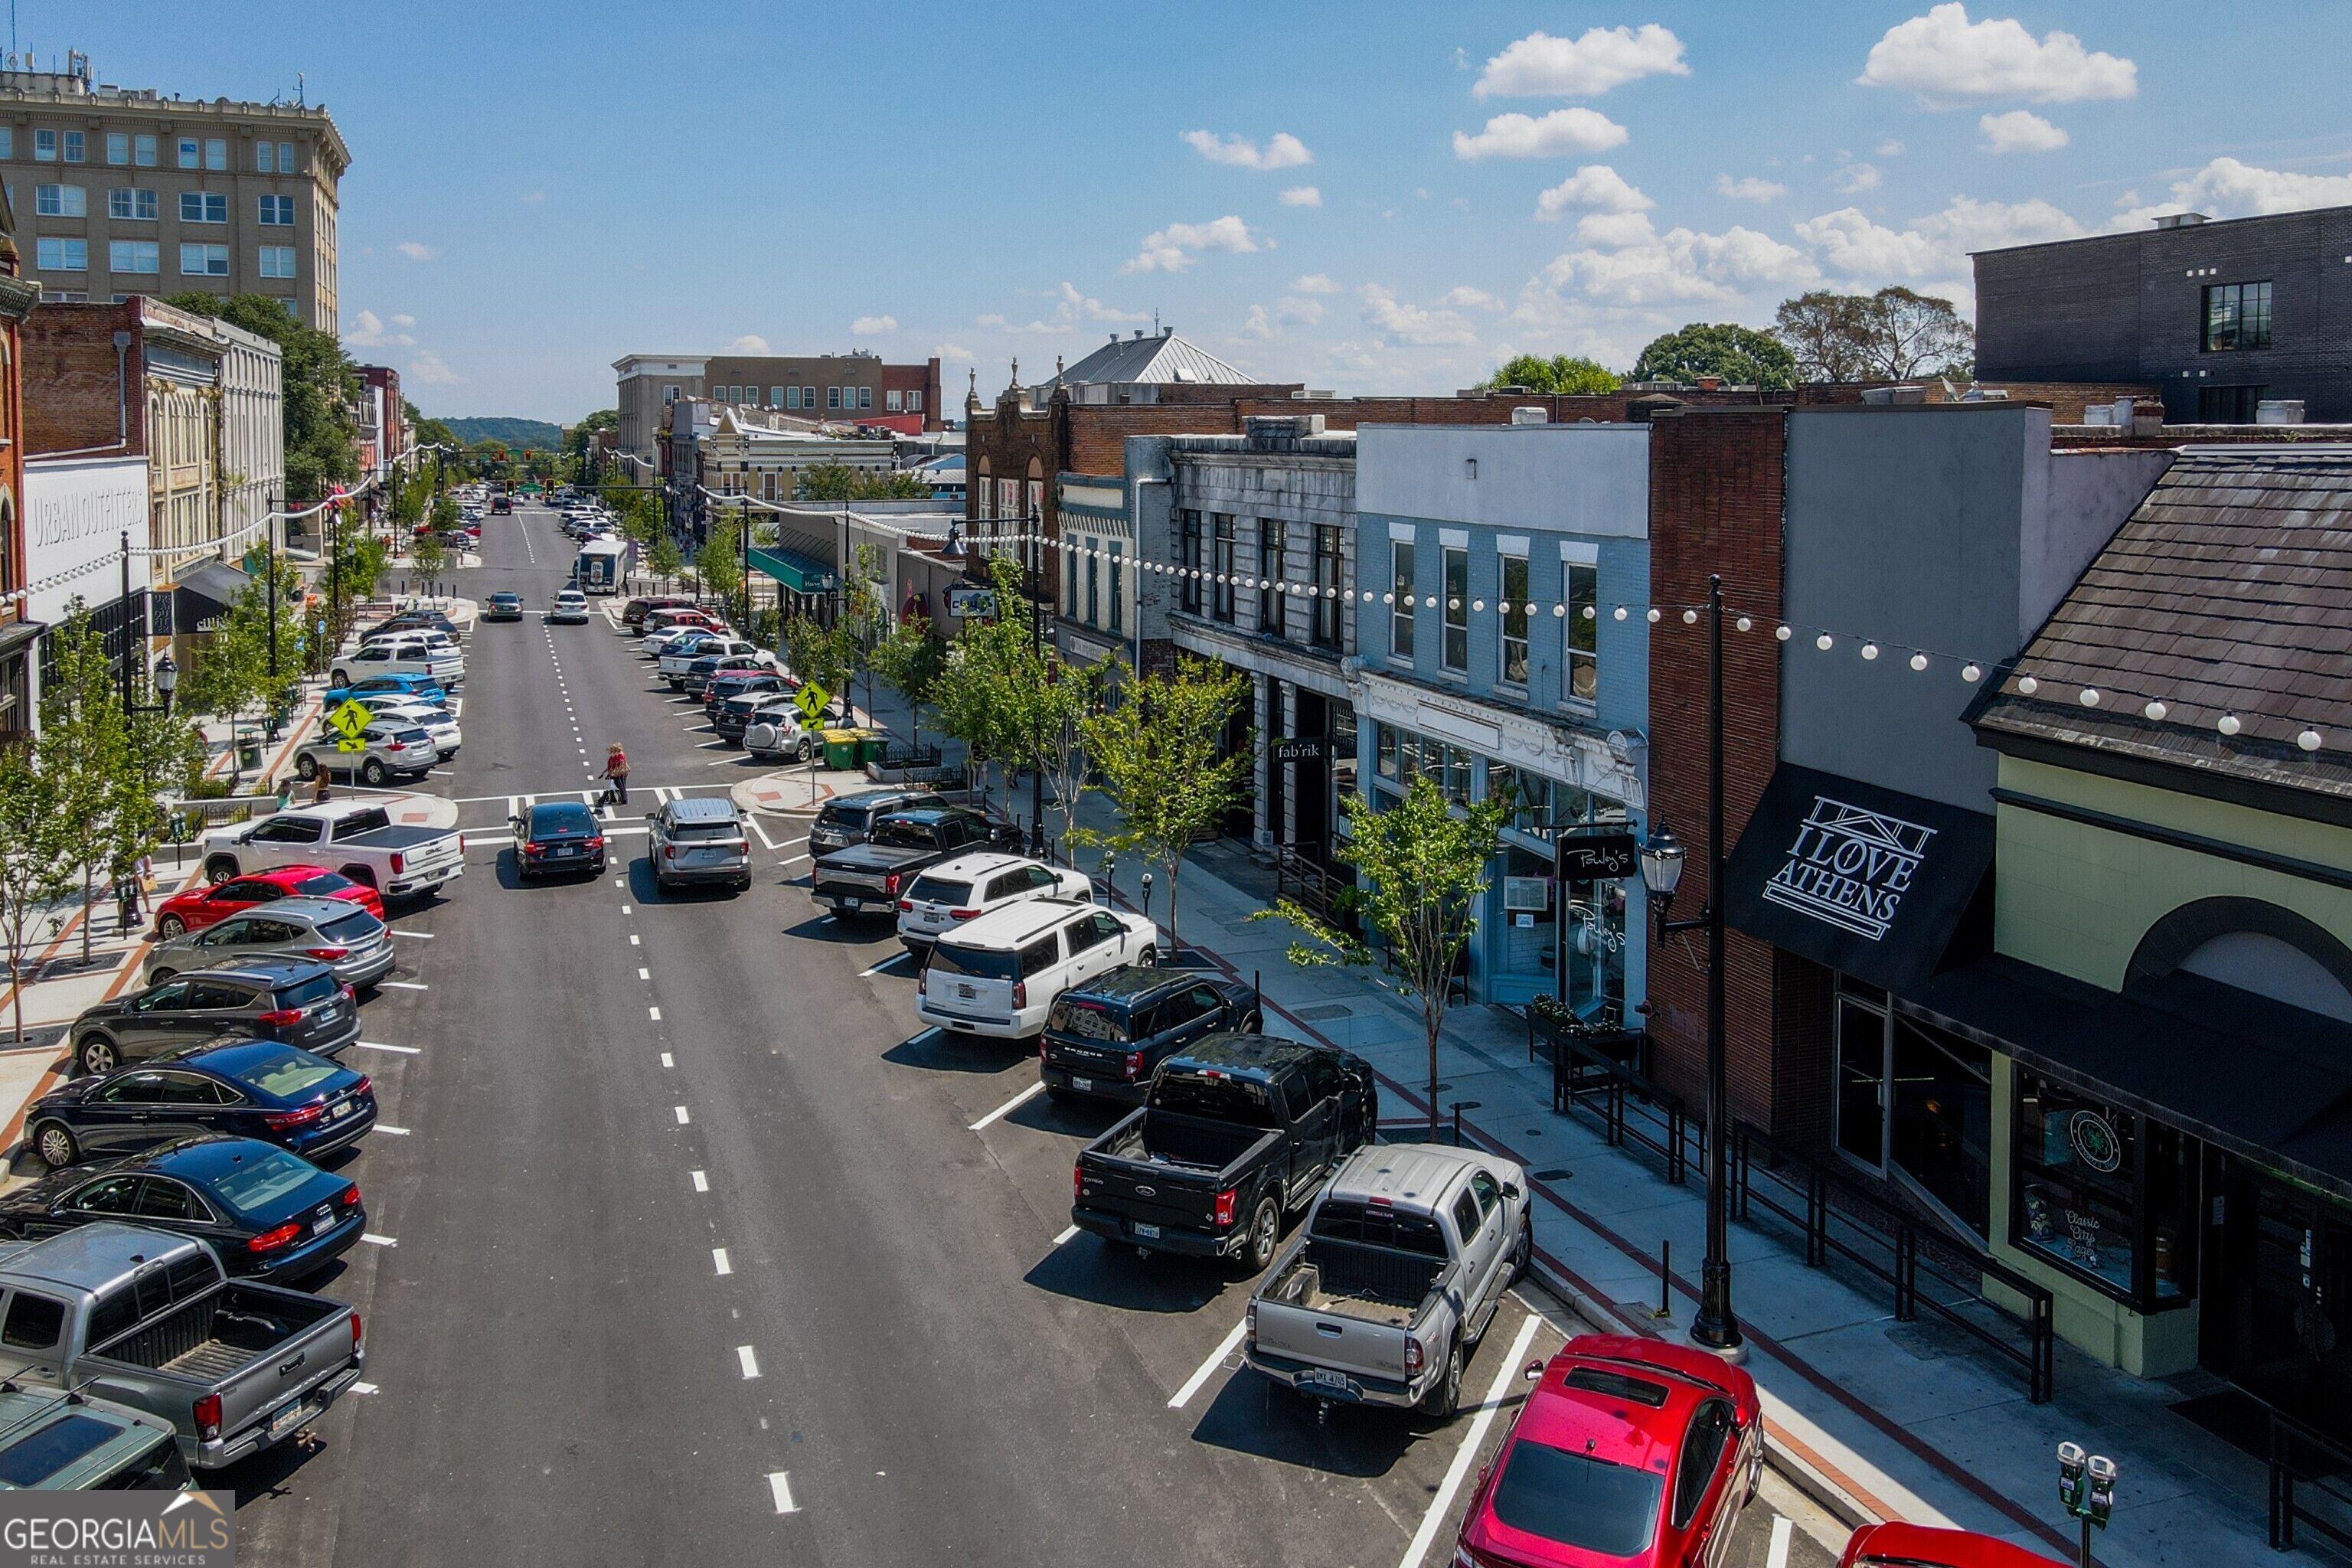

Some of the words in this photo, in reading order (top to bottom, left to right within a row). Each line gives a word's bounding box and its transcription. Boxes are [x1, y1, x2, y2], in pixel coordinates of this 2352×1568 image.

[34, 492, 80, 547] URBAN
[82, 486, 143, 536] OUTFITTERS
[1279, 743, 1319, 758] fab'rik
[1786, 825, 1814, 857] I
[1806, 831, 1919, 892] LOVE
[1772, 858, 1900, 921] ATHENS
[2065, 1209, 2100, 1229] Classic
[2069, 1225, 2096, 1247] City
